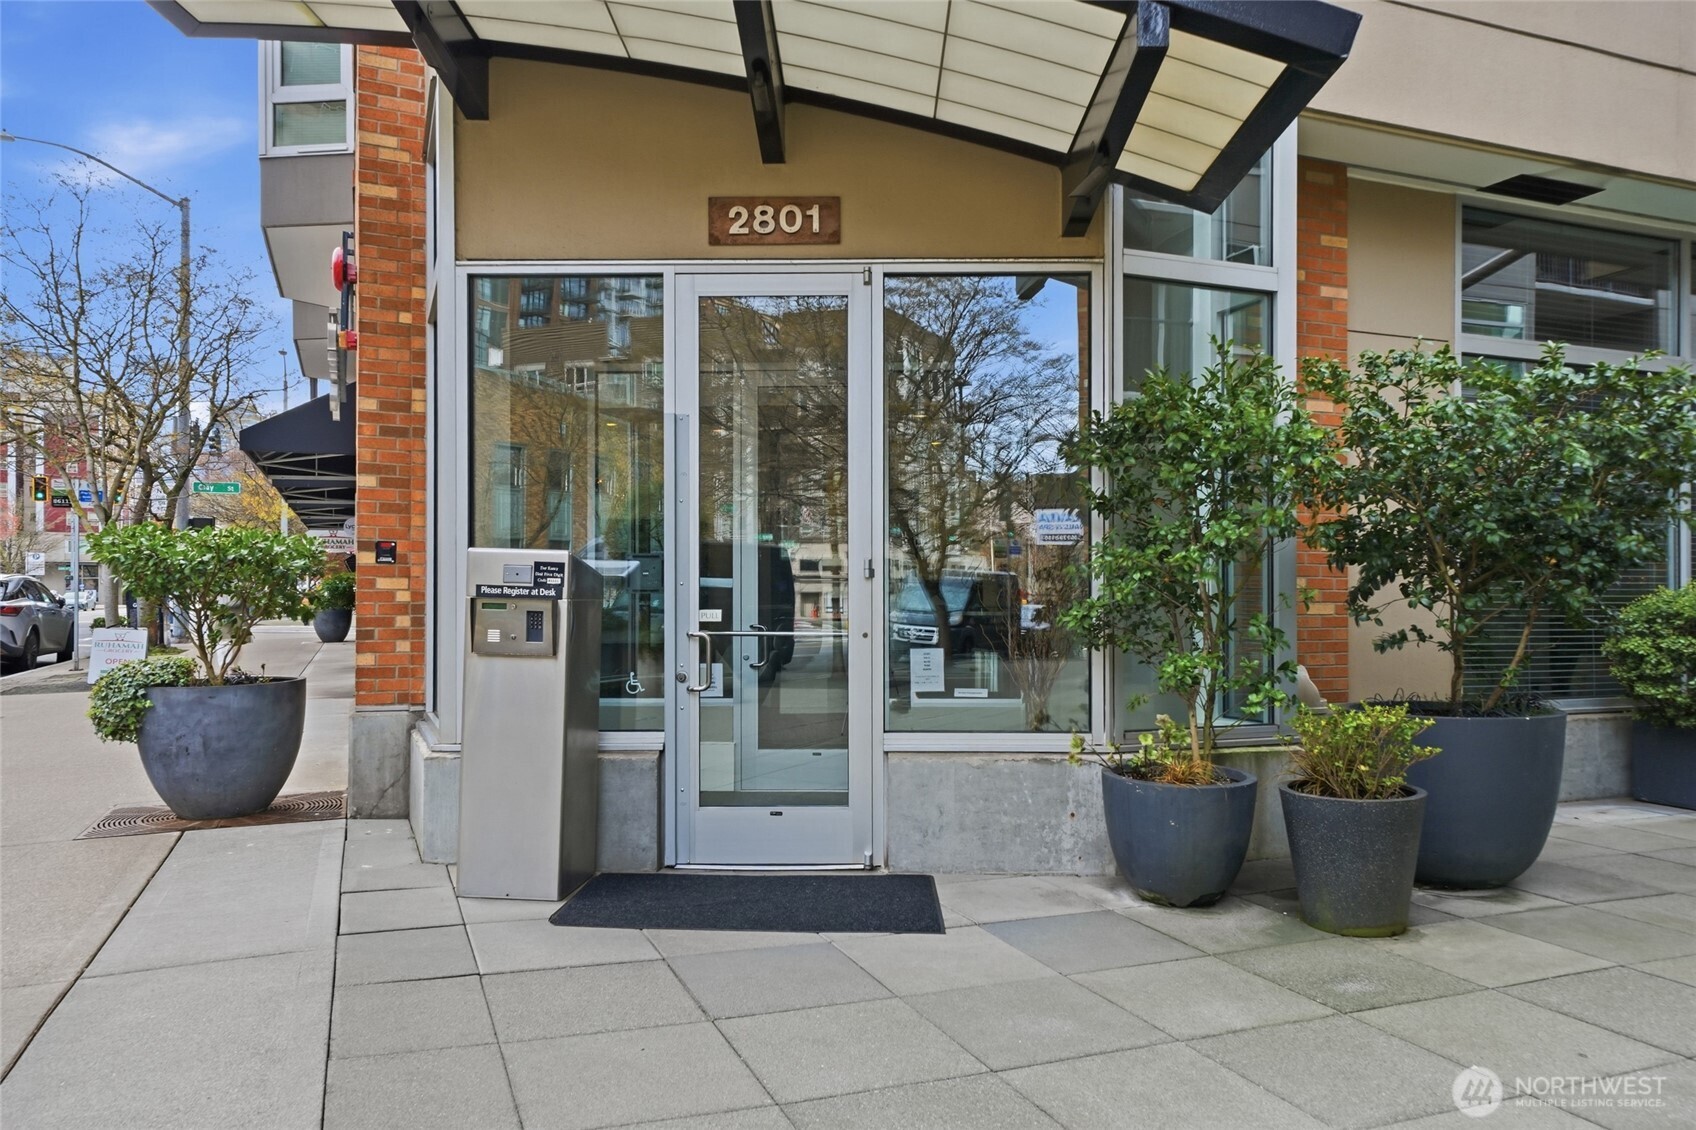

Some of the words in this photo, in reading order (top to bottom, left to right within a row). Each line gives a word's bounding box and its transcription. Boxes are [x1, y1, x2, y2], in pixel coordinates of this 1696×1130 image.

[728, 204, 820, 235] 2801
[198, 484, 214, 492] Clay
[481, 585, 502, 594] Please
[503, 586, 530, 597] Register
[531, 588, 538, 596] at
[539, 587, 556, 596] Desk
